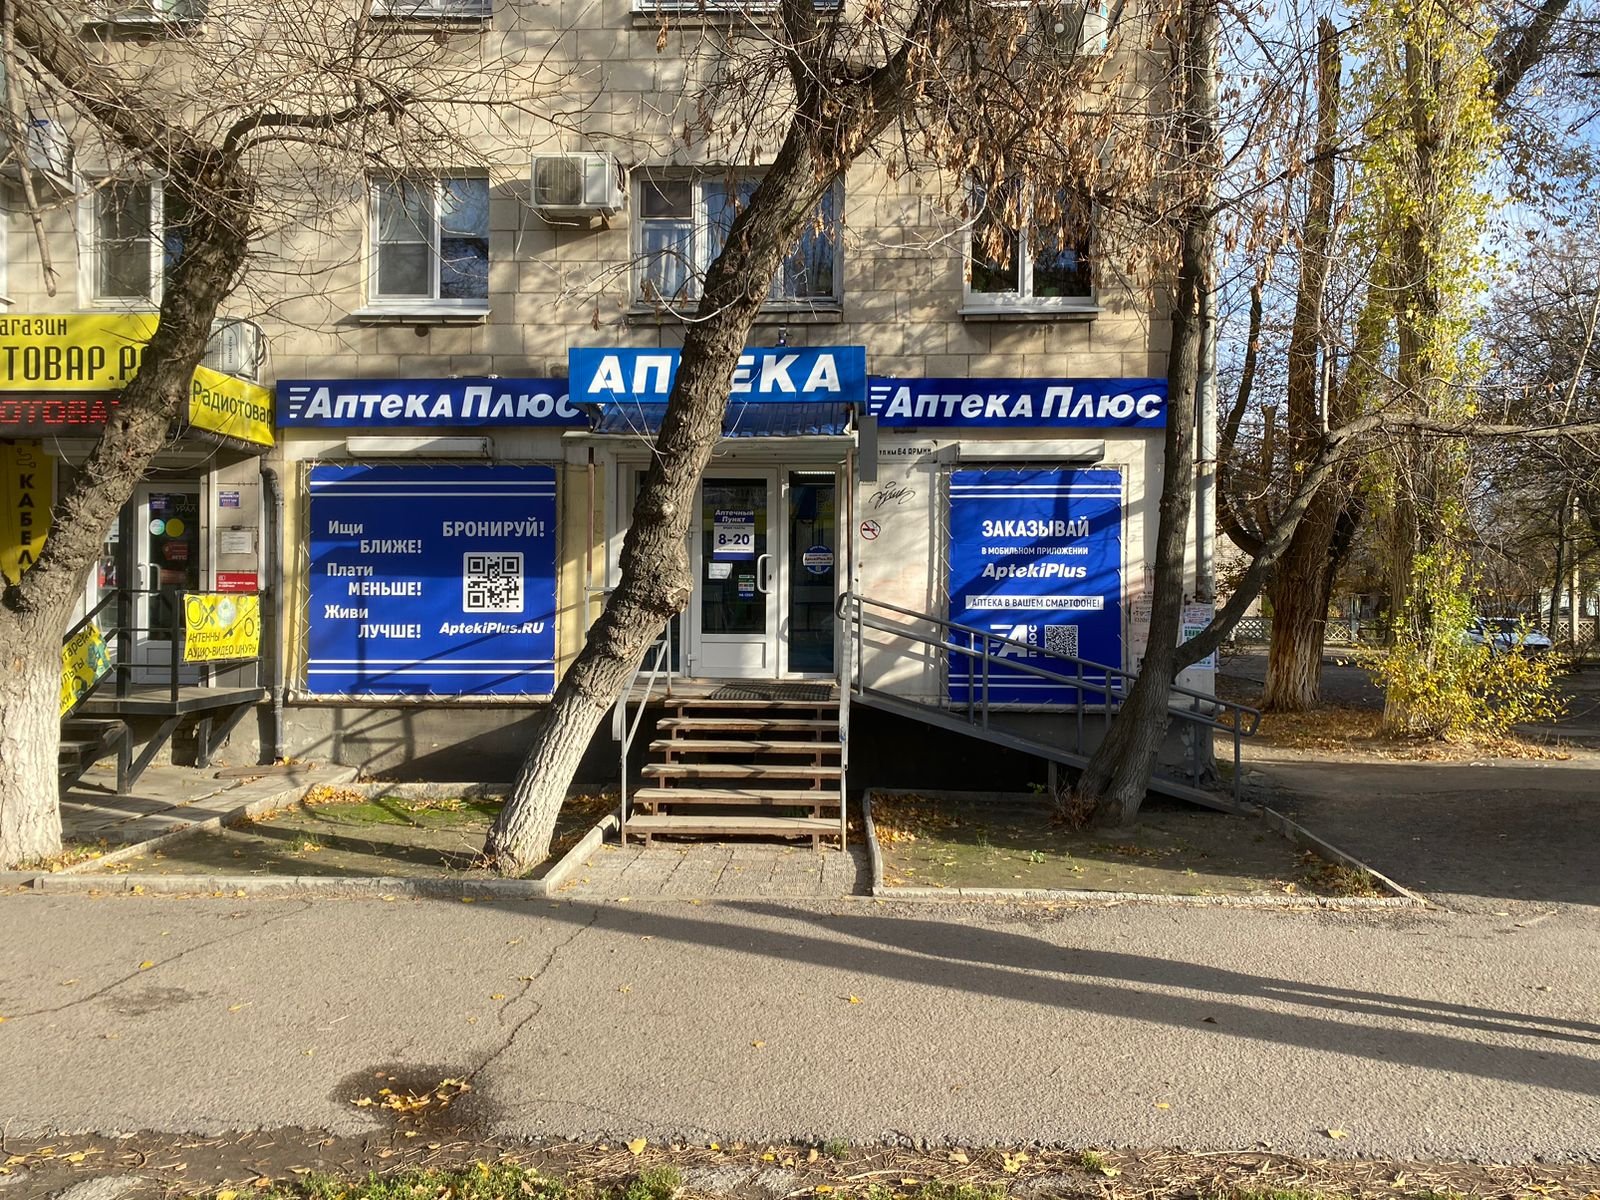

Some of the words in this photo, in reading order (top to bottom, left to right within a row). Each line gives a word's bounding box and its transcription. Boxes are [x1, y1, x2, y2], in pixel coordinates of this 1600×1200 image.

[2, 345, 149, 381] ТОВАР.Р
[587, 354, 842, 394] АПЕКА
[328, 520, 364, 536] Ищи
[442, 517, 546, 538] БРОНИРУЙ!
[981, 515, 1090, 537] ЗАКАЗЫВАЙ
[360, 539, 422, 555] БЛИЖЕ!
[718, 533, 750, 545] 8-20
[988, 547, 1035, 555] МОБИЛЬНОМ
[1036, 546, 1089, 555] ПРИЛОЖЕНИИ
[327, 562, 374, 578] Плати
[981, 562, 1088, 581] AptekiPlus
[348, 581, 422, 597] МЕНЬШЕ!
[972, 598, 1002, 607] АПТЕКА
[1004, 598, 1010, 607] В
[1012, 598, 1044, 607] ВАШЕМ
[1045, 597, 1100, 608] СМАРТФОНЕ!
[324, 604, 369, 620] Живи
[358, 623, 422, 640] ЛУЧШЕ!
[439, 622, 545, 636] AptekiPlus.RU
